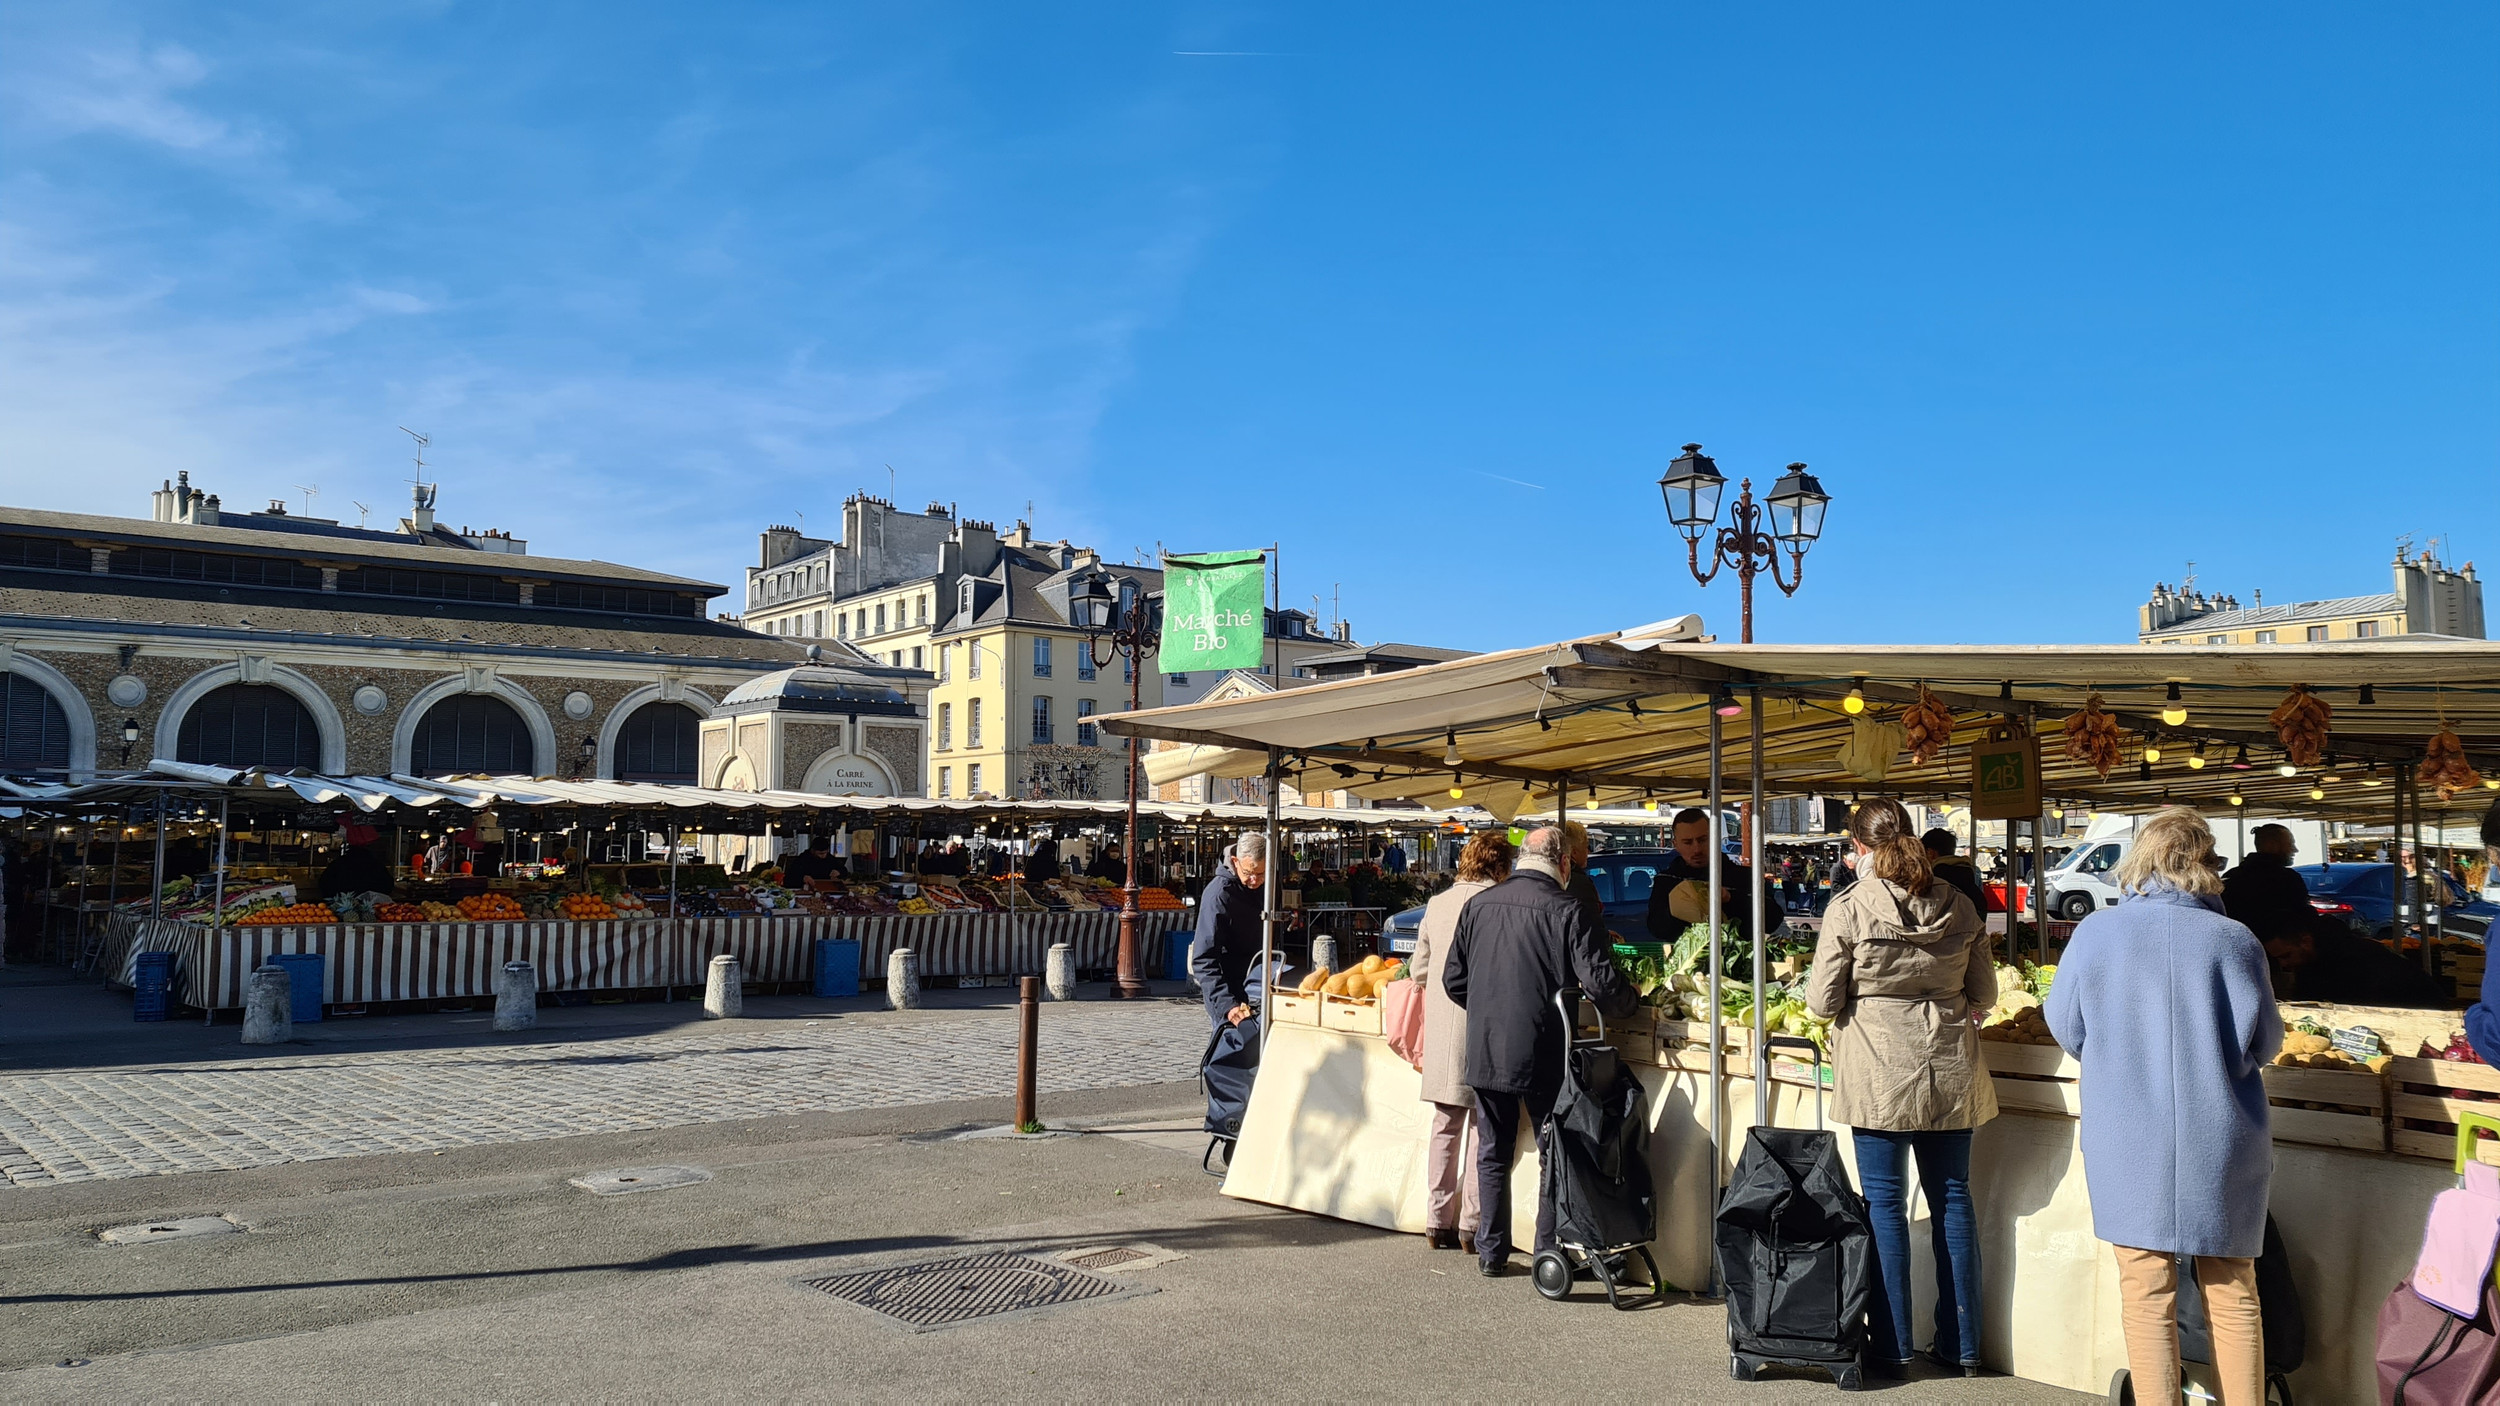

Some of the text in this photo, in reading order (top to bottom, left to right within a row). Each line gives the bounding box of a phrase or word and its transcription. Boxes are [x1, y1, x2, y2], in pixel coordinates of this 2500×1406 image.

[1172, 609, 1252, 632] Marché
[1193, 634, 1227, 651] Bio
[1984, 764, 2018, 790] AB
